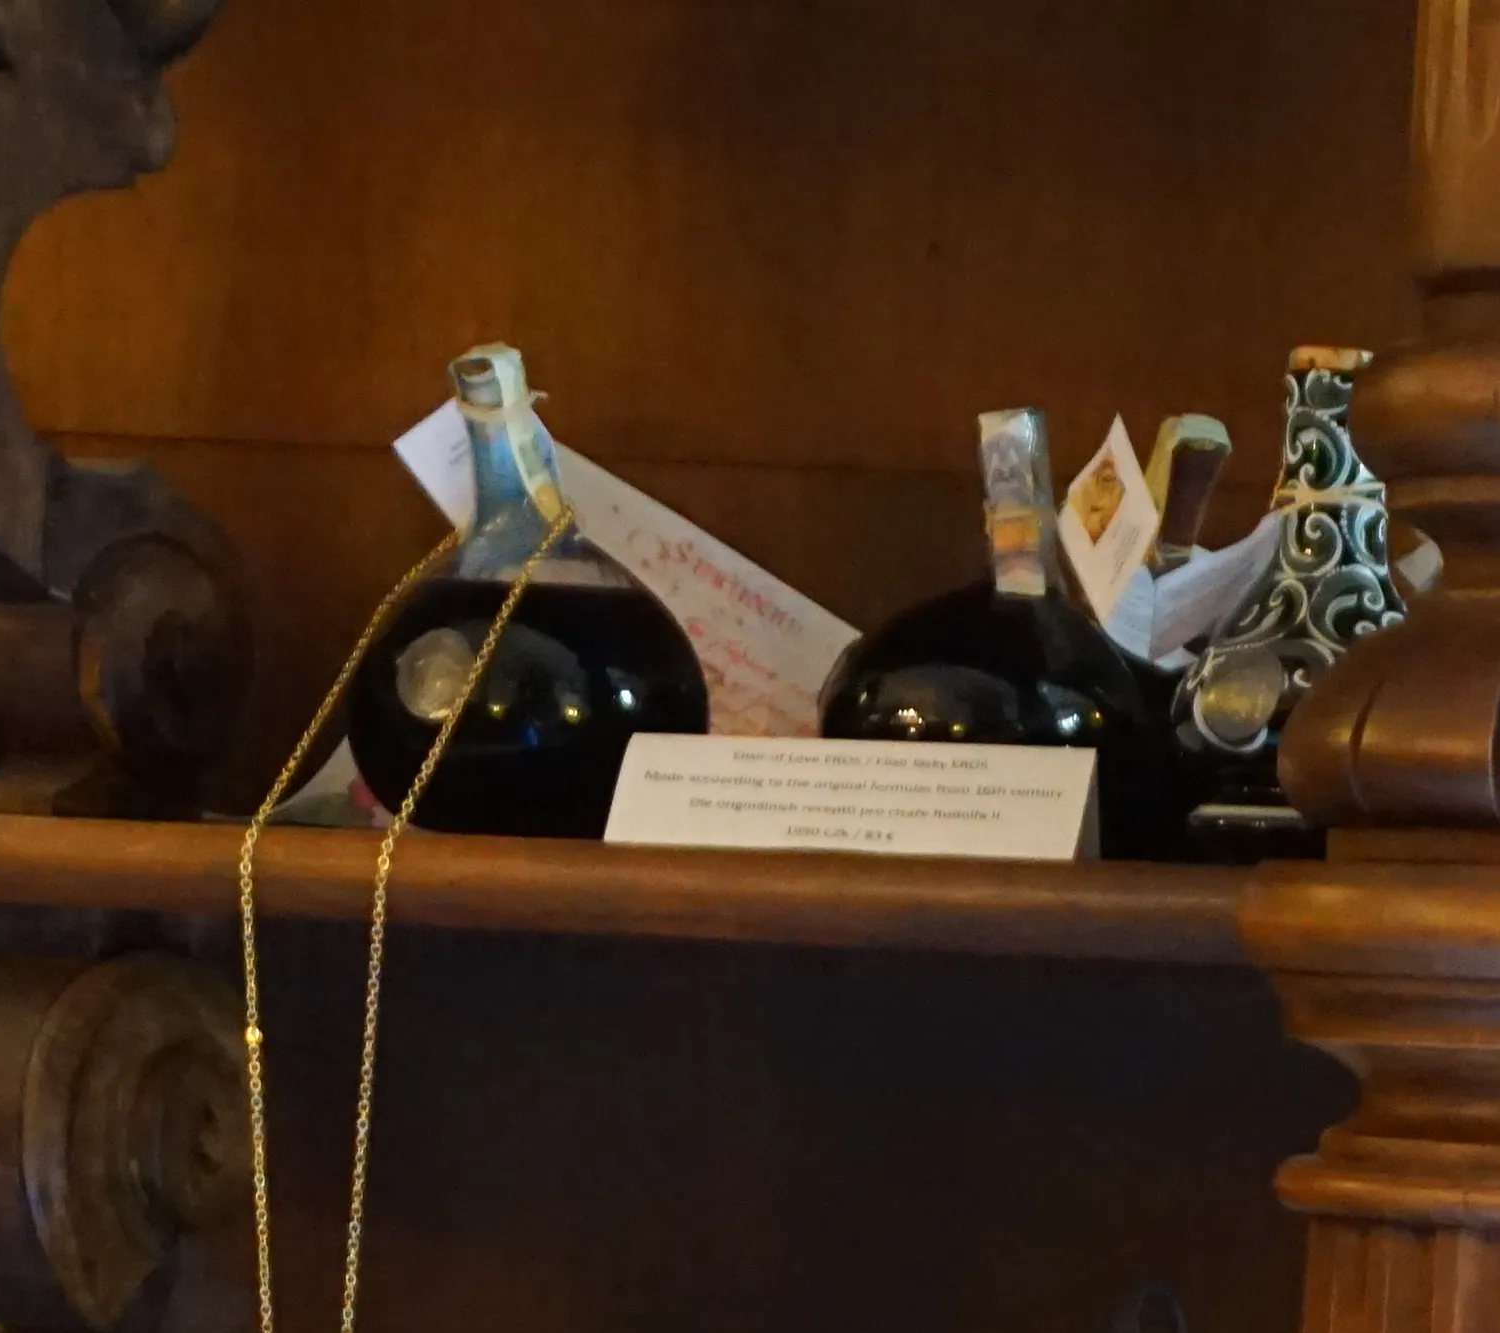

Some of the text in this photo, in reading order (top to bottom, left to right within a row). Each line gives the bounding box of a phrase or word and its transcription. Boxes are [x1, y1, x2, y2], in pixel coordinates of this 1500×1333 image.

[789, 752, 819, 765] Love
[645, 769, 684, 784] Made
[687, 771, 763, 789] according
[768, 775, 784, 787] to
[787, 776, 811, 789] the
[815, 777, 867, 795] original
